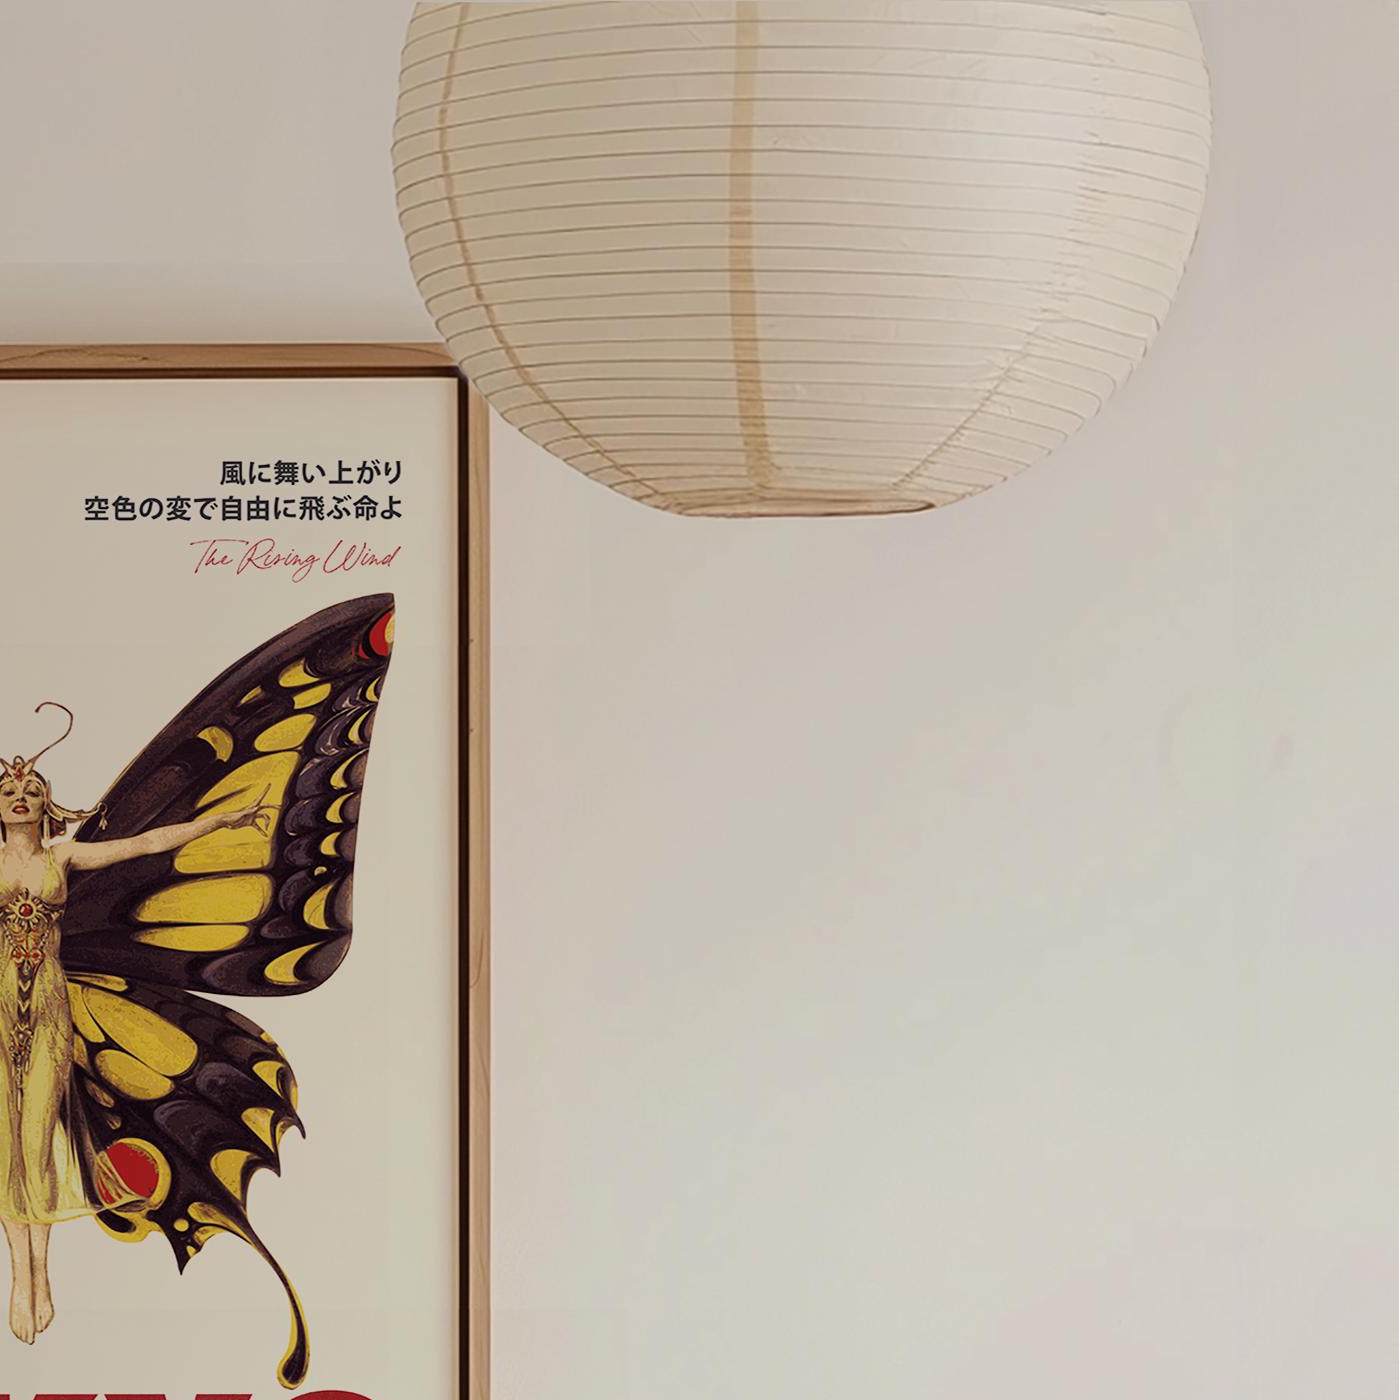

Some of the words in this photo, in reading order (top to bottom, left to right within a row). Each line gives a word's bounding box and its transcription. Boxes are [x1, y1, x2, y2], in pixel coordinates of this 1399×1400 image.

[220, 459, 402, 486] 風に舞い上がり
[84, 495, 403, 521] 空色の変で自由に飛ぶ命よ
[190, 538, 249, 575] The
[237, 538, 320, 583] Rising
[322, 539, 402, 574] Wind
